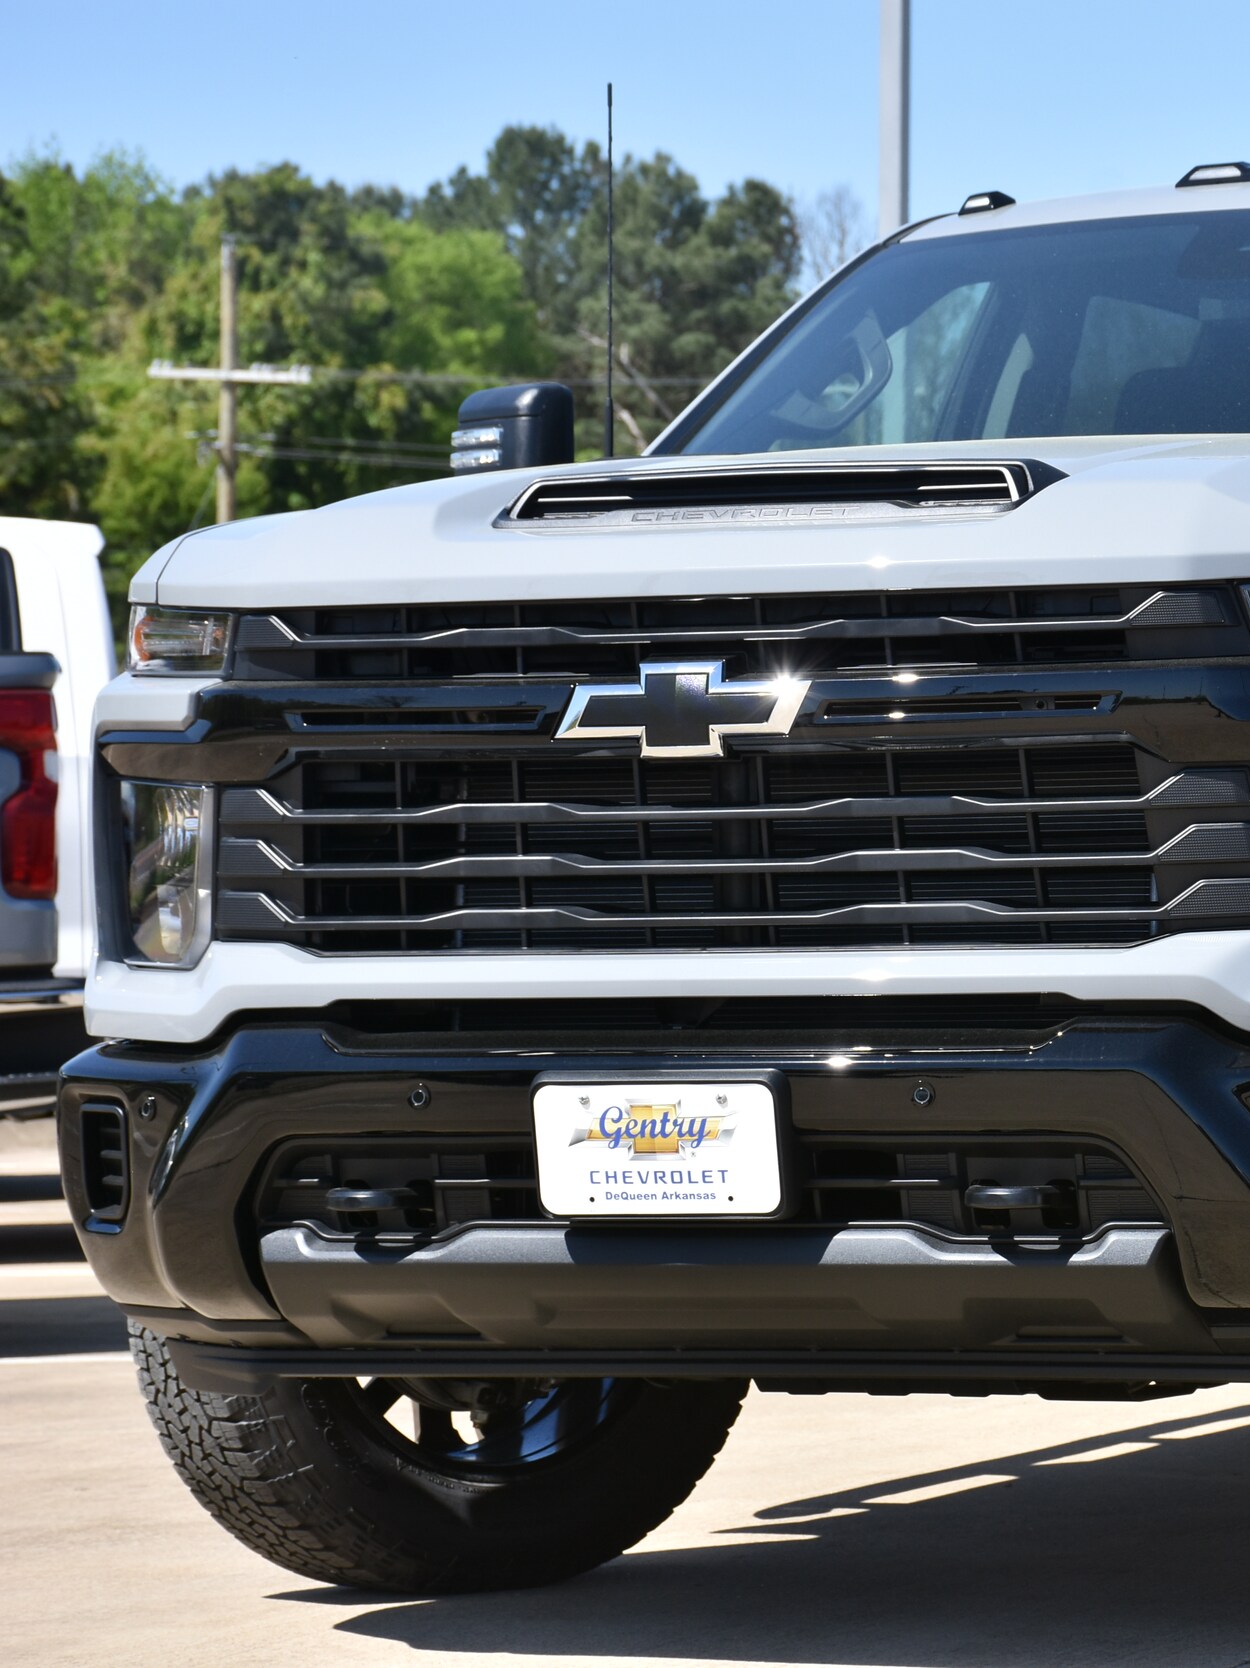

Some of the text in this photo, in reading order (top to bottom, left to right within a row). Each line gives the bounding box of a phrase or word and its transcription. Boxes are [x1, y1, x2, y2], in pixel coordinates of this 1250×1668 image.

[631, 506, 860, 523] CHEVROLET
[599, 1105, 711, 1149] Gentry
[589, 1169, 729, 1185] CHEVROLET
[605, 1191, 716, 1201] DeQueen Arkansas
